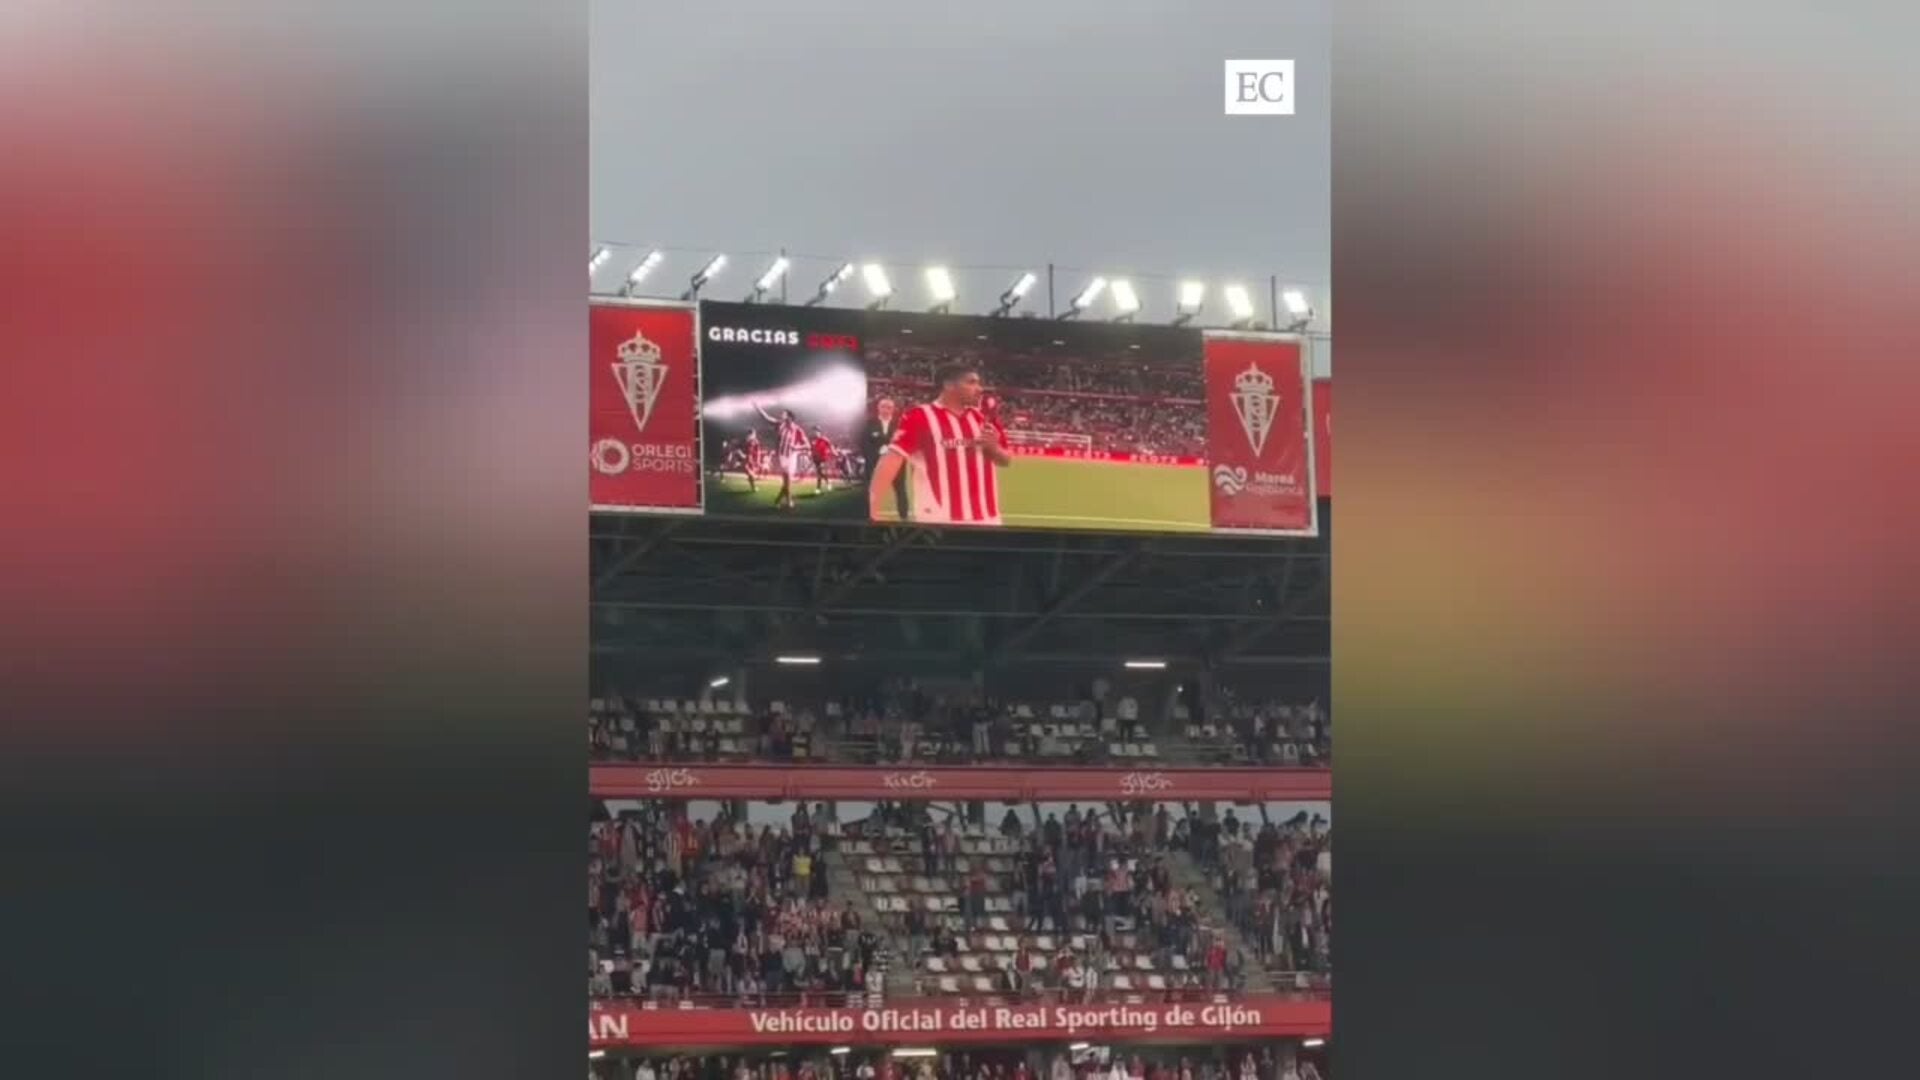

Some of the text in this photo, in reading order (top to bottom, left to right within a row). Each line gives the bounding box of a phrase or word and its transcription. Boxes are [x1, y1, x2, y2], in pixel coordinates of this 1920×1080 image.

[708, 326, 799, 345] GRACIAS
[632, 443, 692, 458] ORLEGI
[633, 458, 694, 473] SPORTS
[751, 1004, 1261, 1032] Vehículo Oficial del Real Sporting de Gijón
